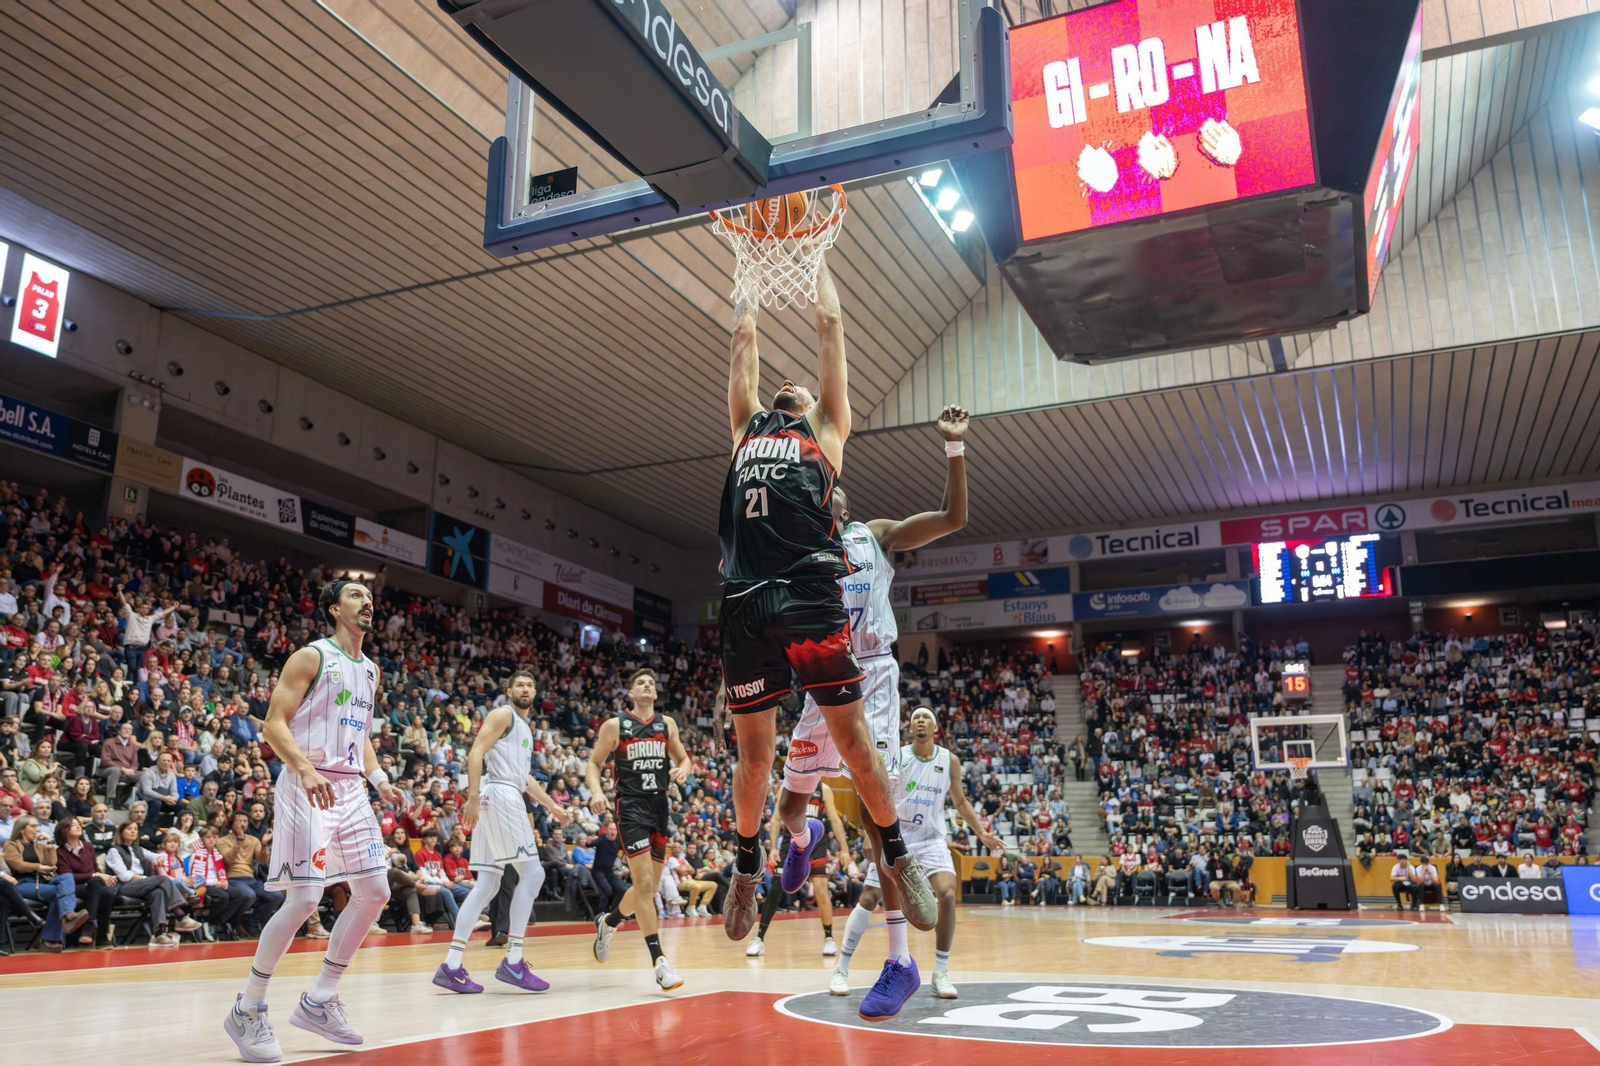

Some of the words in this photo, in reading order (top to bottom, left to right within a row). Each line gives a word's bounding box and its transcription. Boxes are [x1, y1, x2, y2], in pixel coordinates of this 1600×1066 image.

[532, 184, 551, 197] liga
[31, 298, 49, 319] 3
[27, 411, 56, 438] S.A.
[737, 463, 788, 487] FIATC
[217, 483, 265, 509] Plantes
[745, 487, 769, 518] 21
[1459, 489, 1570, 519] Tecnical
[310, 520, 319, 529] de
[311, 510, 348, 529] Suplements
[1260, 511, 1367, 538] SPAR
[1096, 525, 1200, 555] Tecnical
[557, 591, 581, 611] Diari
[581, 599, 594, 614] de
[594, 604, 623, 624] Girona
[1003, 600, 1048, 613] Estanys
[1107, 592, 1150, 605] infosoft
[1024, 611, 1056, 624] Blaus
[733, 678, 765, 699] YOSOY
[1284, 676, 1306, 692] 15
[626, 740, 667, 761] GIRONA
[632, 758, 664, 771] FIATC
[641, 772, 658, 791] 23
[911, 813, 924, 826] 6
[1298, 866, 1340, 877] BeGreat
[1461, 881, 1563, 901] endesa
